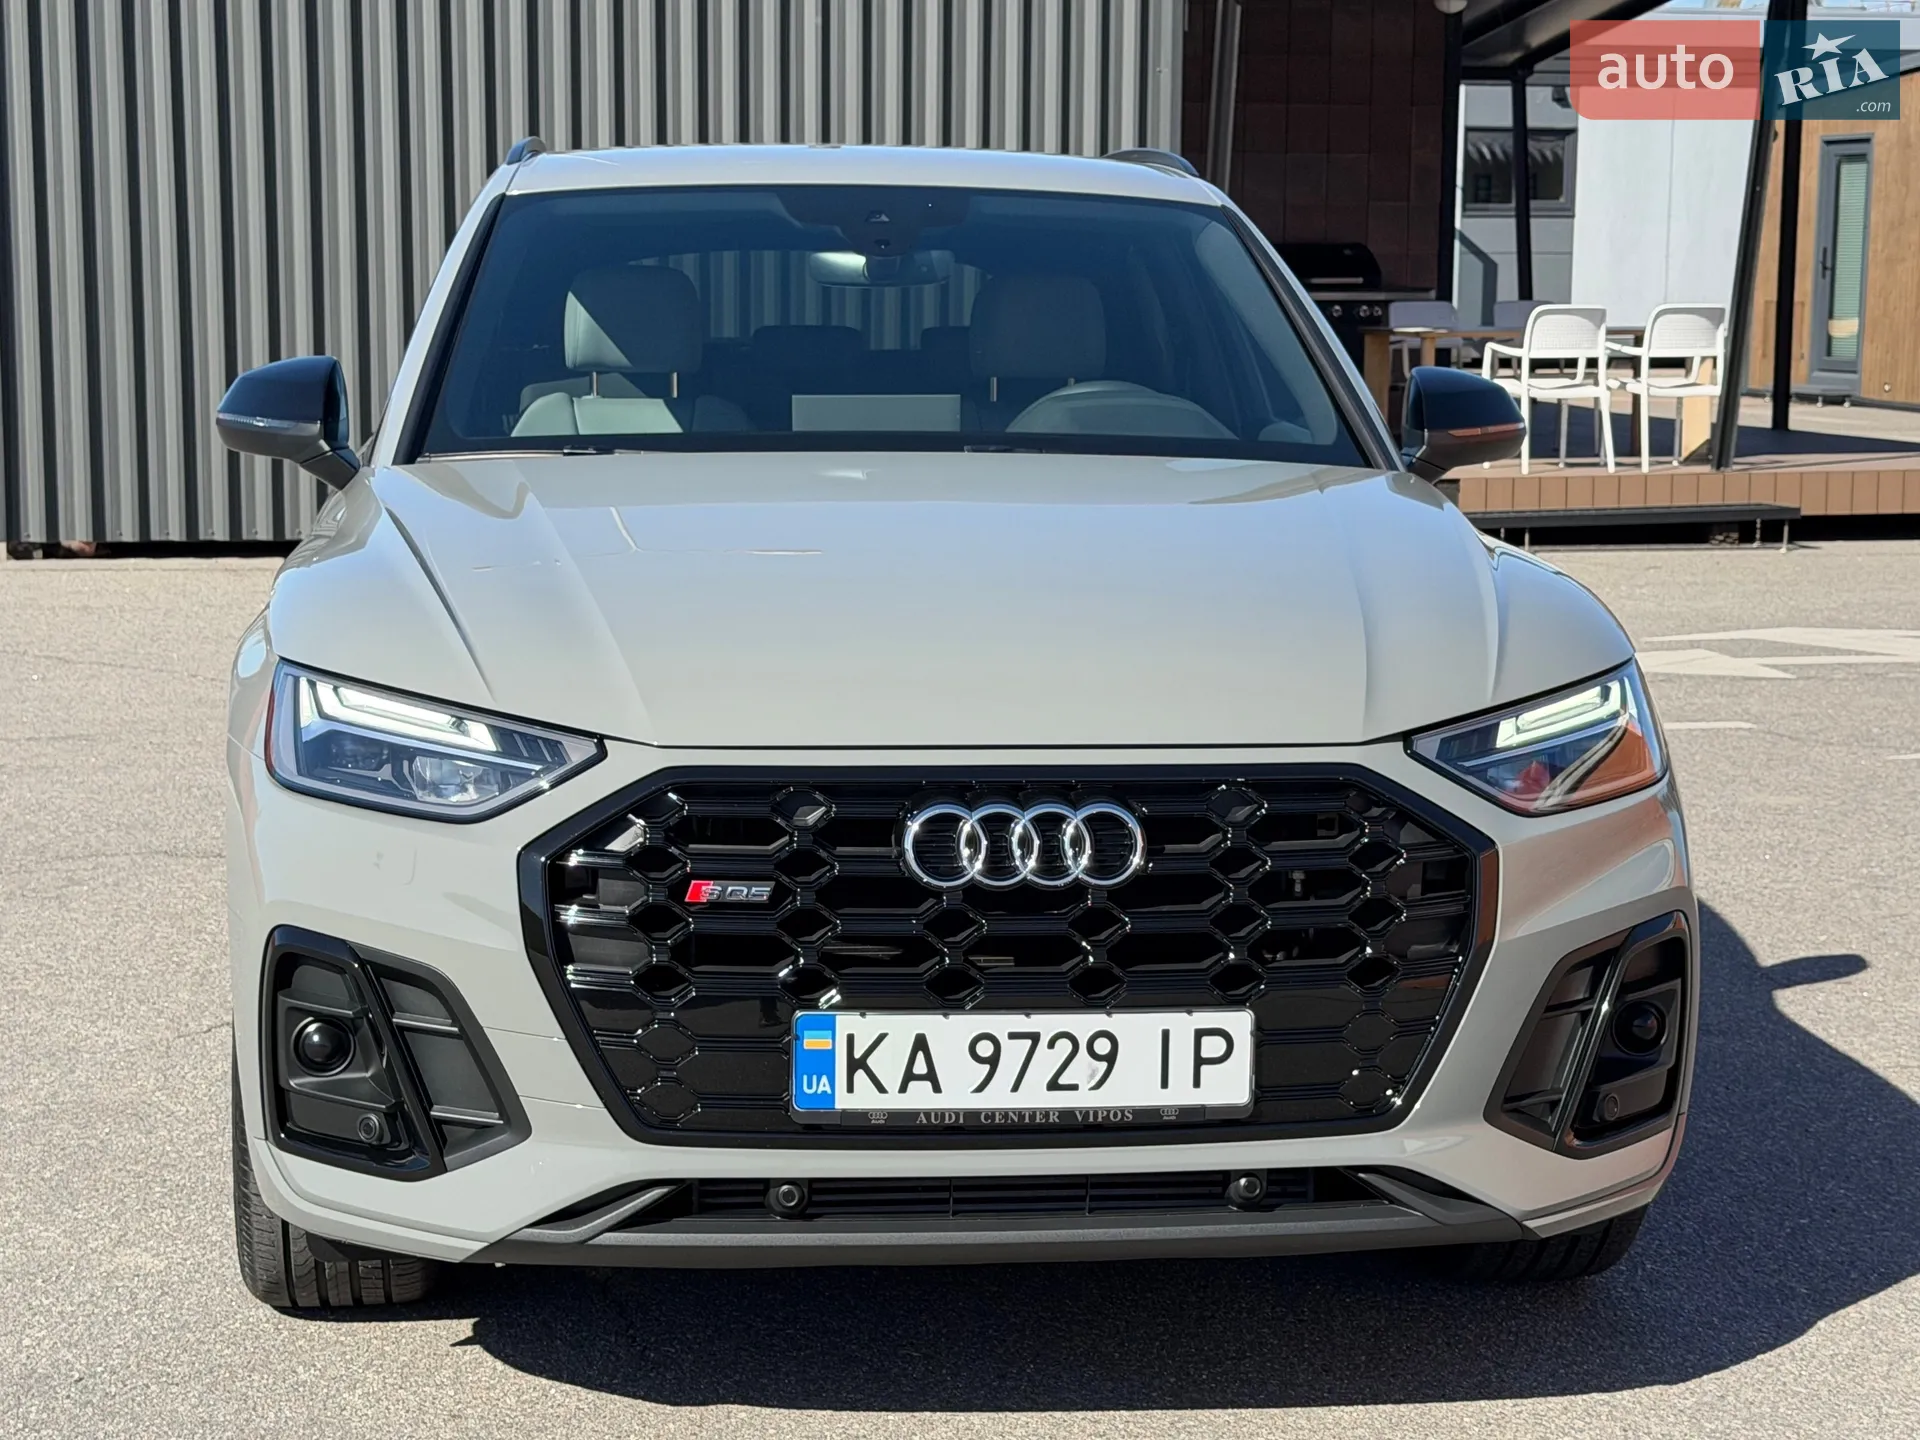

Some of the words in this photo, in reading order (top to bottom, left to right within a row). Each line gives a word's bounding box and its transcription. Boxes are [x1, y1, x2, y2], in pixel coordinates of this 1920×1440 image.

[701, 886, 771, 901] SQ5
[846, 1032, 943, 1094] KA
[968, 1029, 1119, 1093] 9729
[1160, 1027, 1235, 1090] IP
[803, 1074, 832, 1095] UA
[916, 1112, 965, 1125] AUDI
[980, 1111, 1061, 1124] CENTER
[1075, 1109, 1134, 1122] VIPOS
